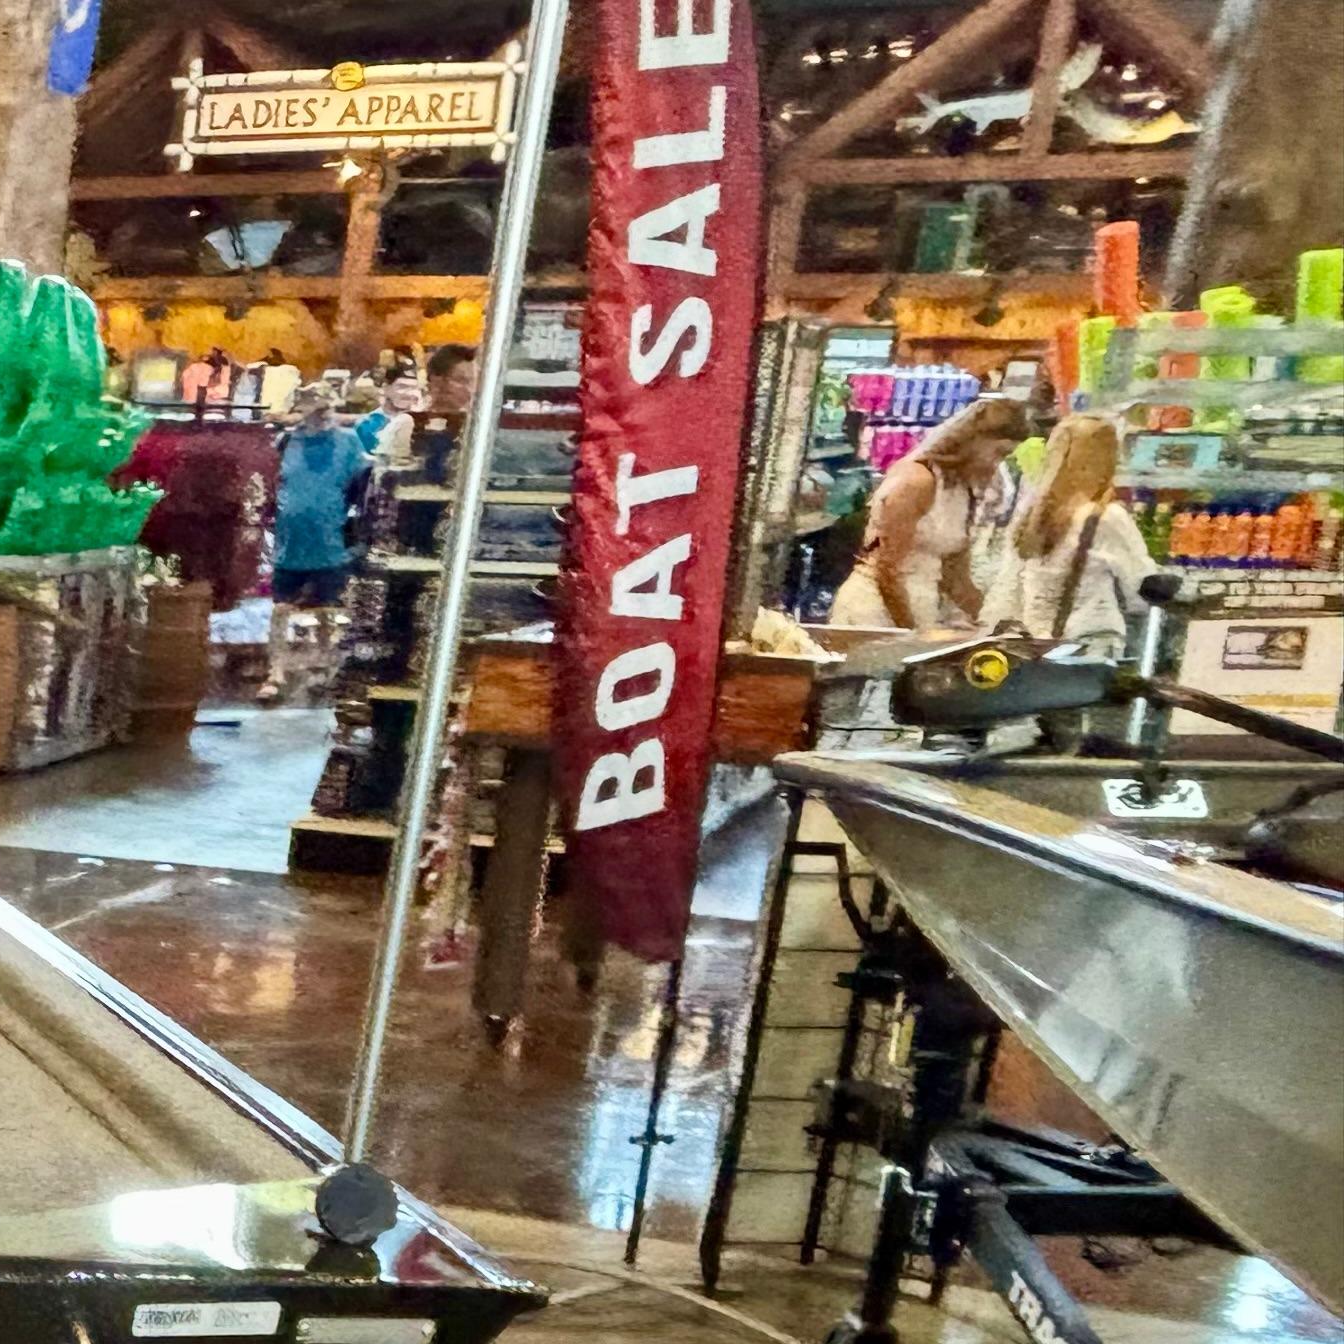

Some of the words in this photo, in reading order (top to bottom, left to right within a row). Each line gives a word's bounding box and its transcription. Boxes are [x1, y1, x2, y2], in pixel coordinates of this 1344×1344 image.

[208, 97, 330, 130] LADIES'
[336, 91, 483, 126] APPAREL
[628, 0, 733, 386] SALE
[575, 452, 699, 832] BOAT
